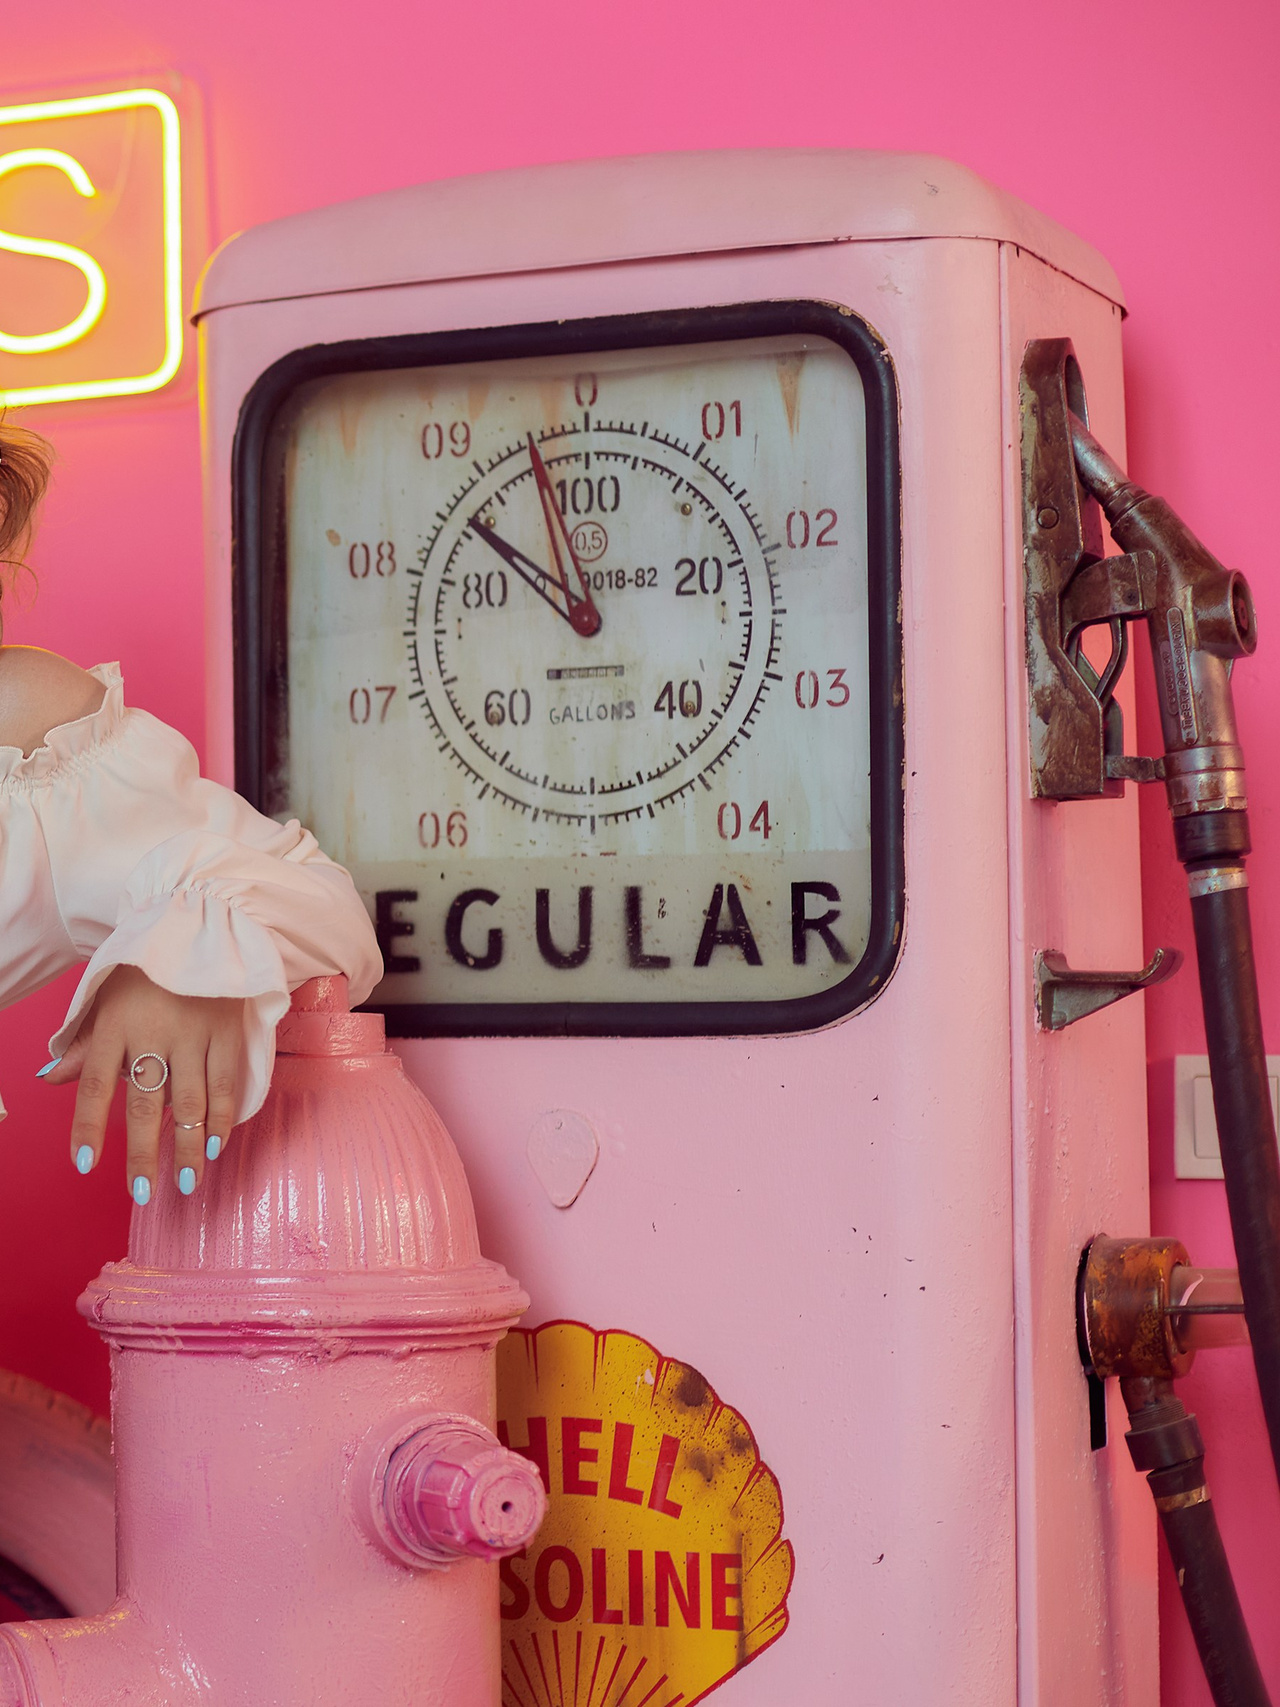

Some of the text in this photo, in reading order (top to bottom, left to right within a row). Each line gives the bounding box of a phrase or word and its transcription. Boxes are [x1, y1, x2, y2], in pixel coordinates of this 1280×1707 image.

[574, 372, 598, 407] 0
[421, 421, 472, 459] 09
[701, 400, 743, 441] 01
[556, 475, 620, 516] 100
[574, 531, 603, 554] 0,5
[786, 508, 839, 548] 02
[348, 541, 397, 578] 08
[675, 556, 723, 596] 20
[462, 571, 508, 610] 80
[349, 686, 397, 724] 07
[483, 687, 531, 727] 60
[654, 679, 702, 719] 40
[795, 669, 851, 709] 03
[550, 701, 636, 724] GALLONS
[418, 810, 468, 848] 06
[717, 800, 772, 841] 04
[375, 881, 854, 974] EGULAR
